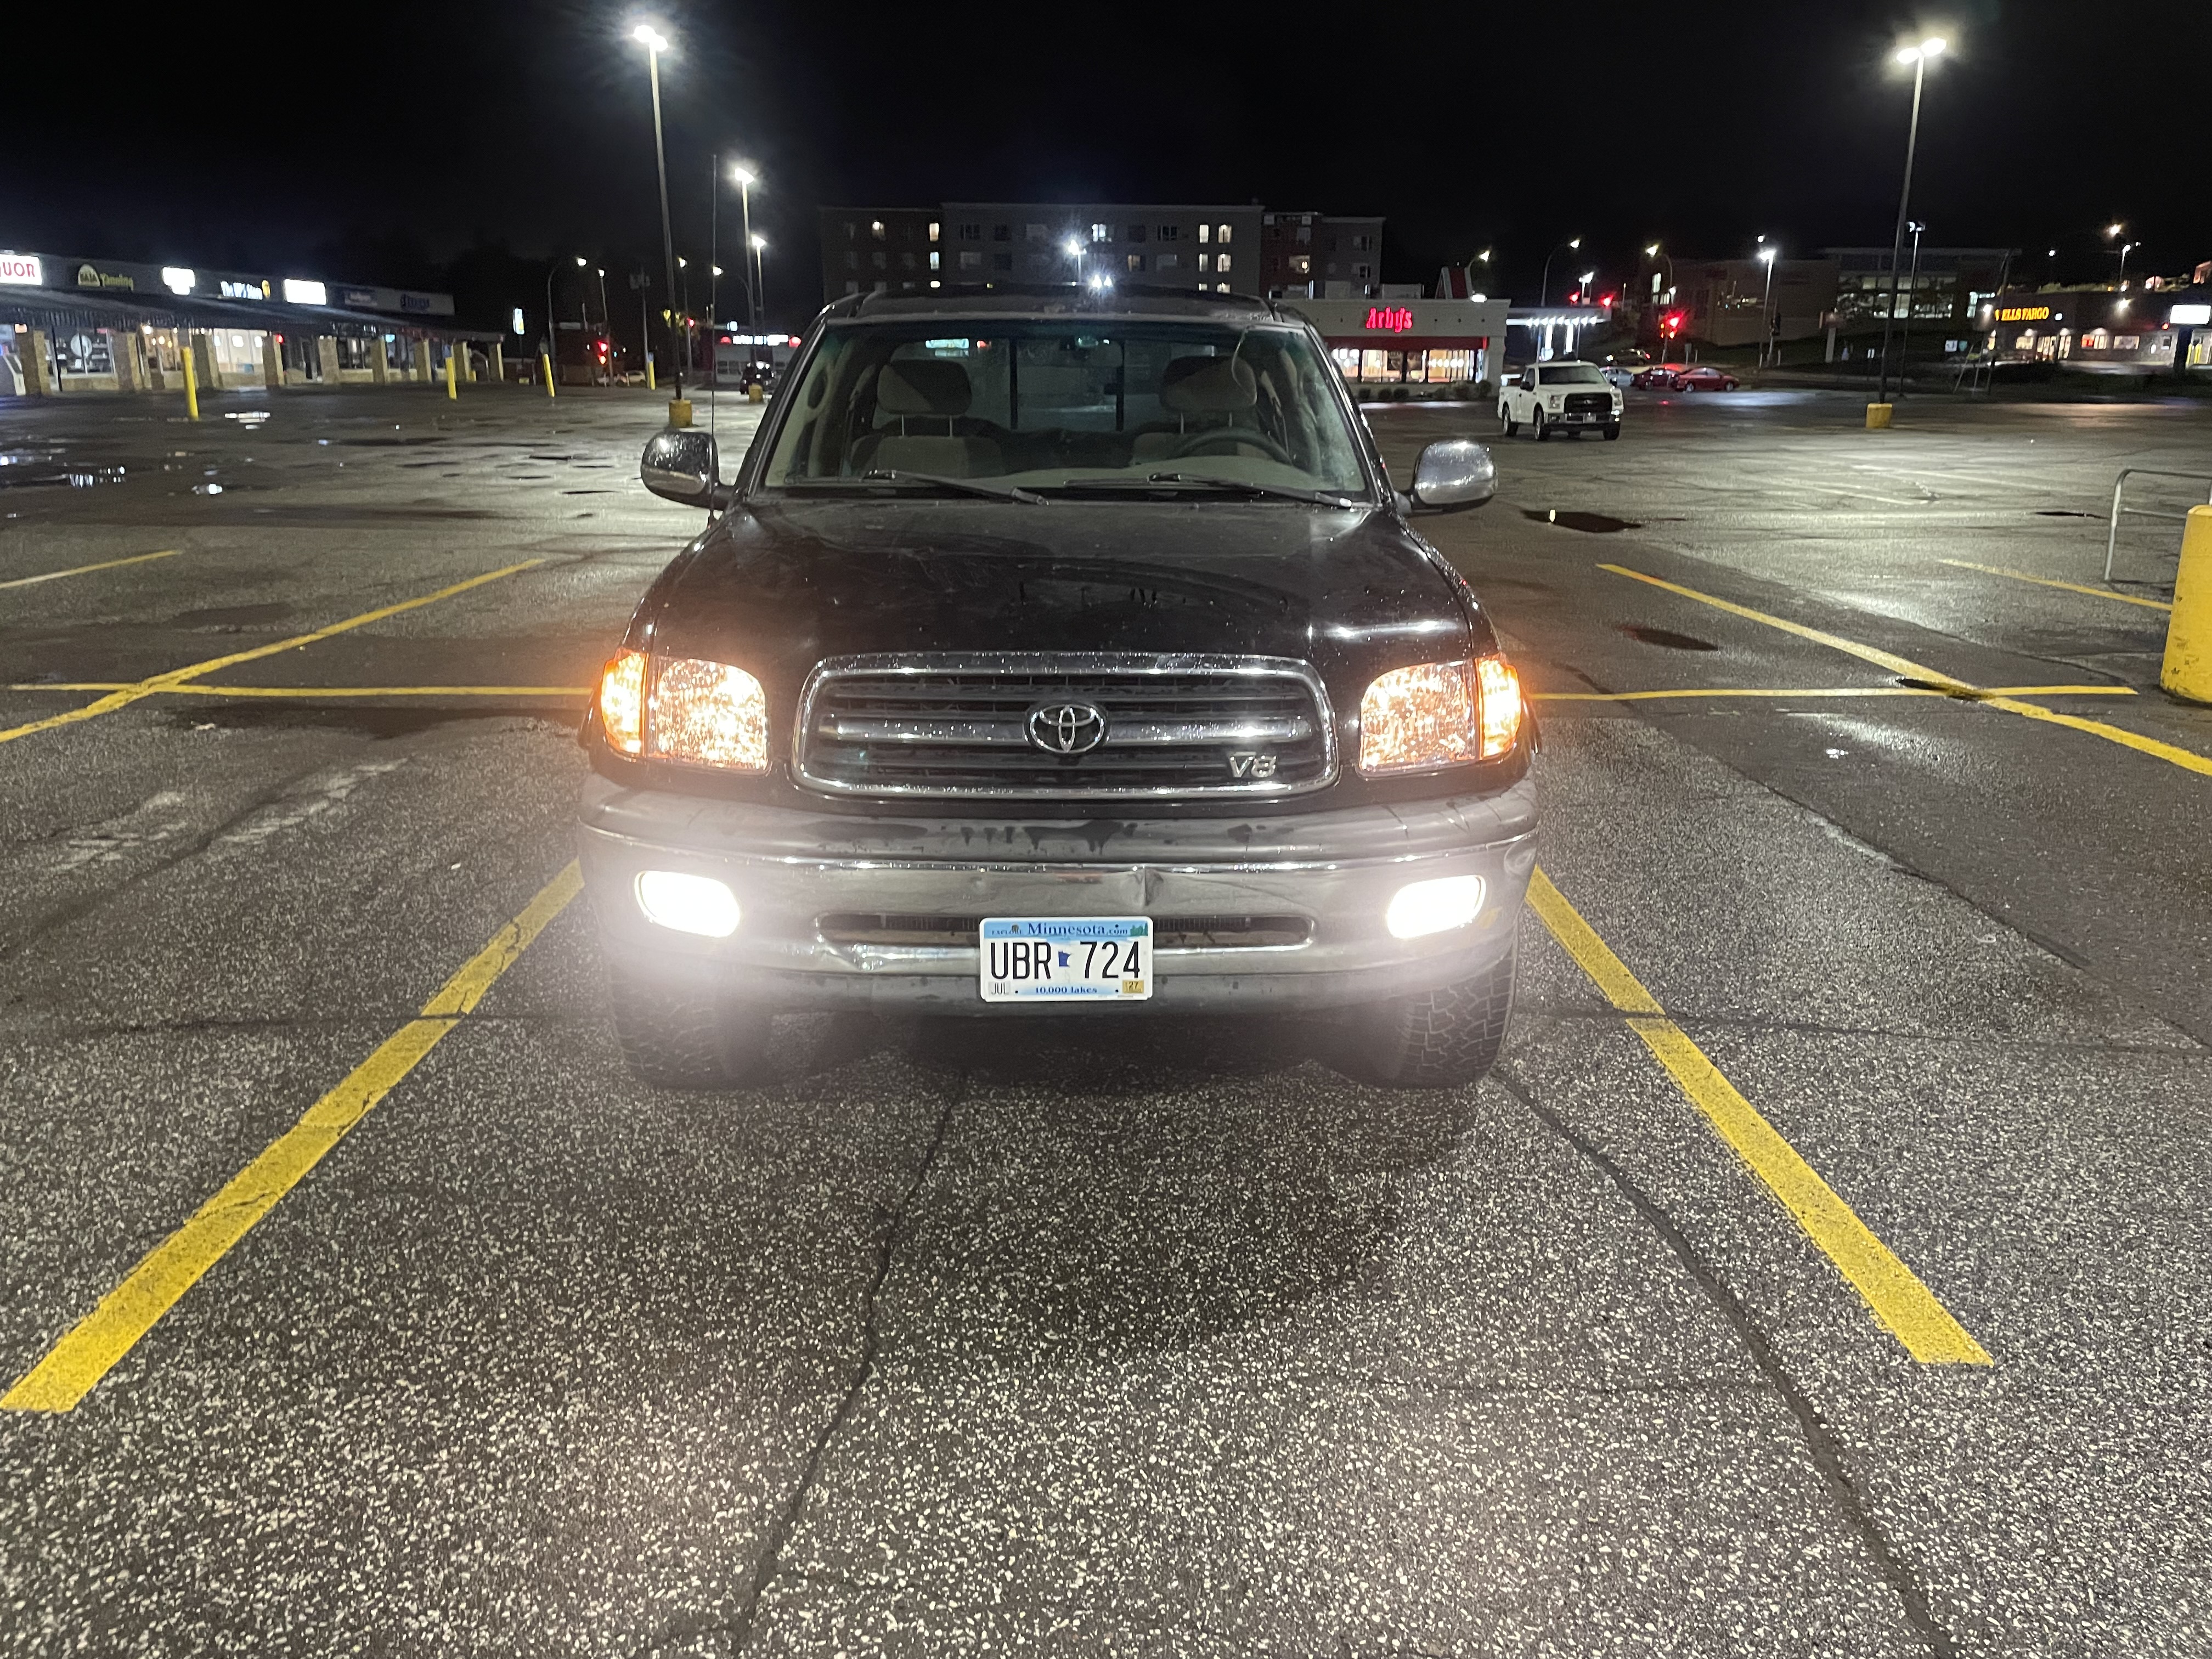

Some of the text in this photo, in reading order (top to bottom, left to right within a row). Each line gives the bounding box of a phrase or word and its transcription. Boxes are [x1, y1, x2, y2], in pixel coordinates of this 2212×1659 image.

[0, 262, 35, 278] UOR
[1228, 751, 1277, 778] V8
[1028, 922, 1105, 935] Minnesota
[990, 941, 1140, 979] UBR 724
[991, 982, 1009, 995] JUL
